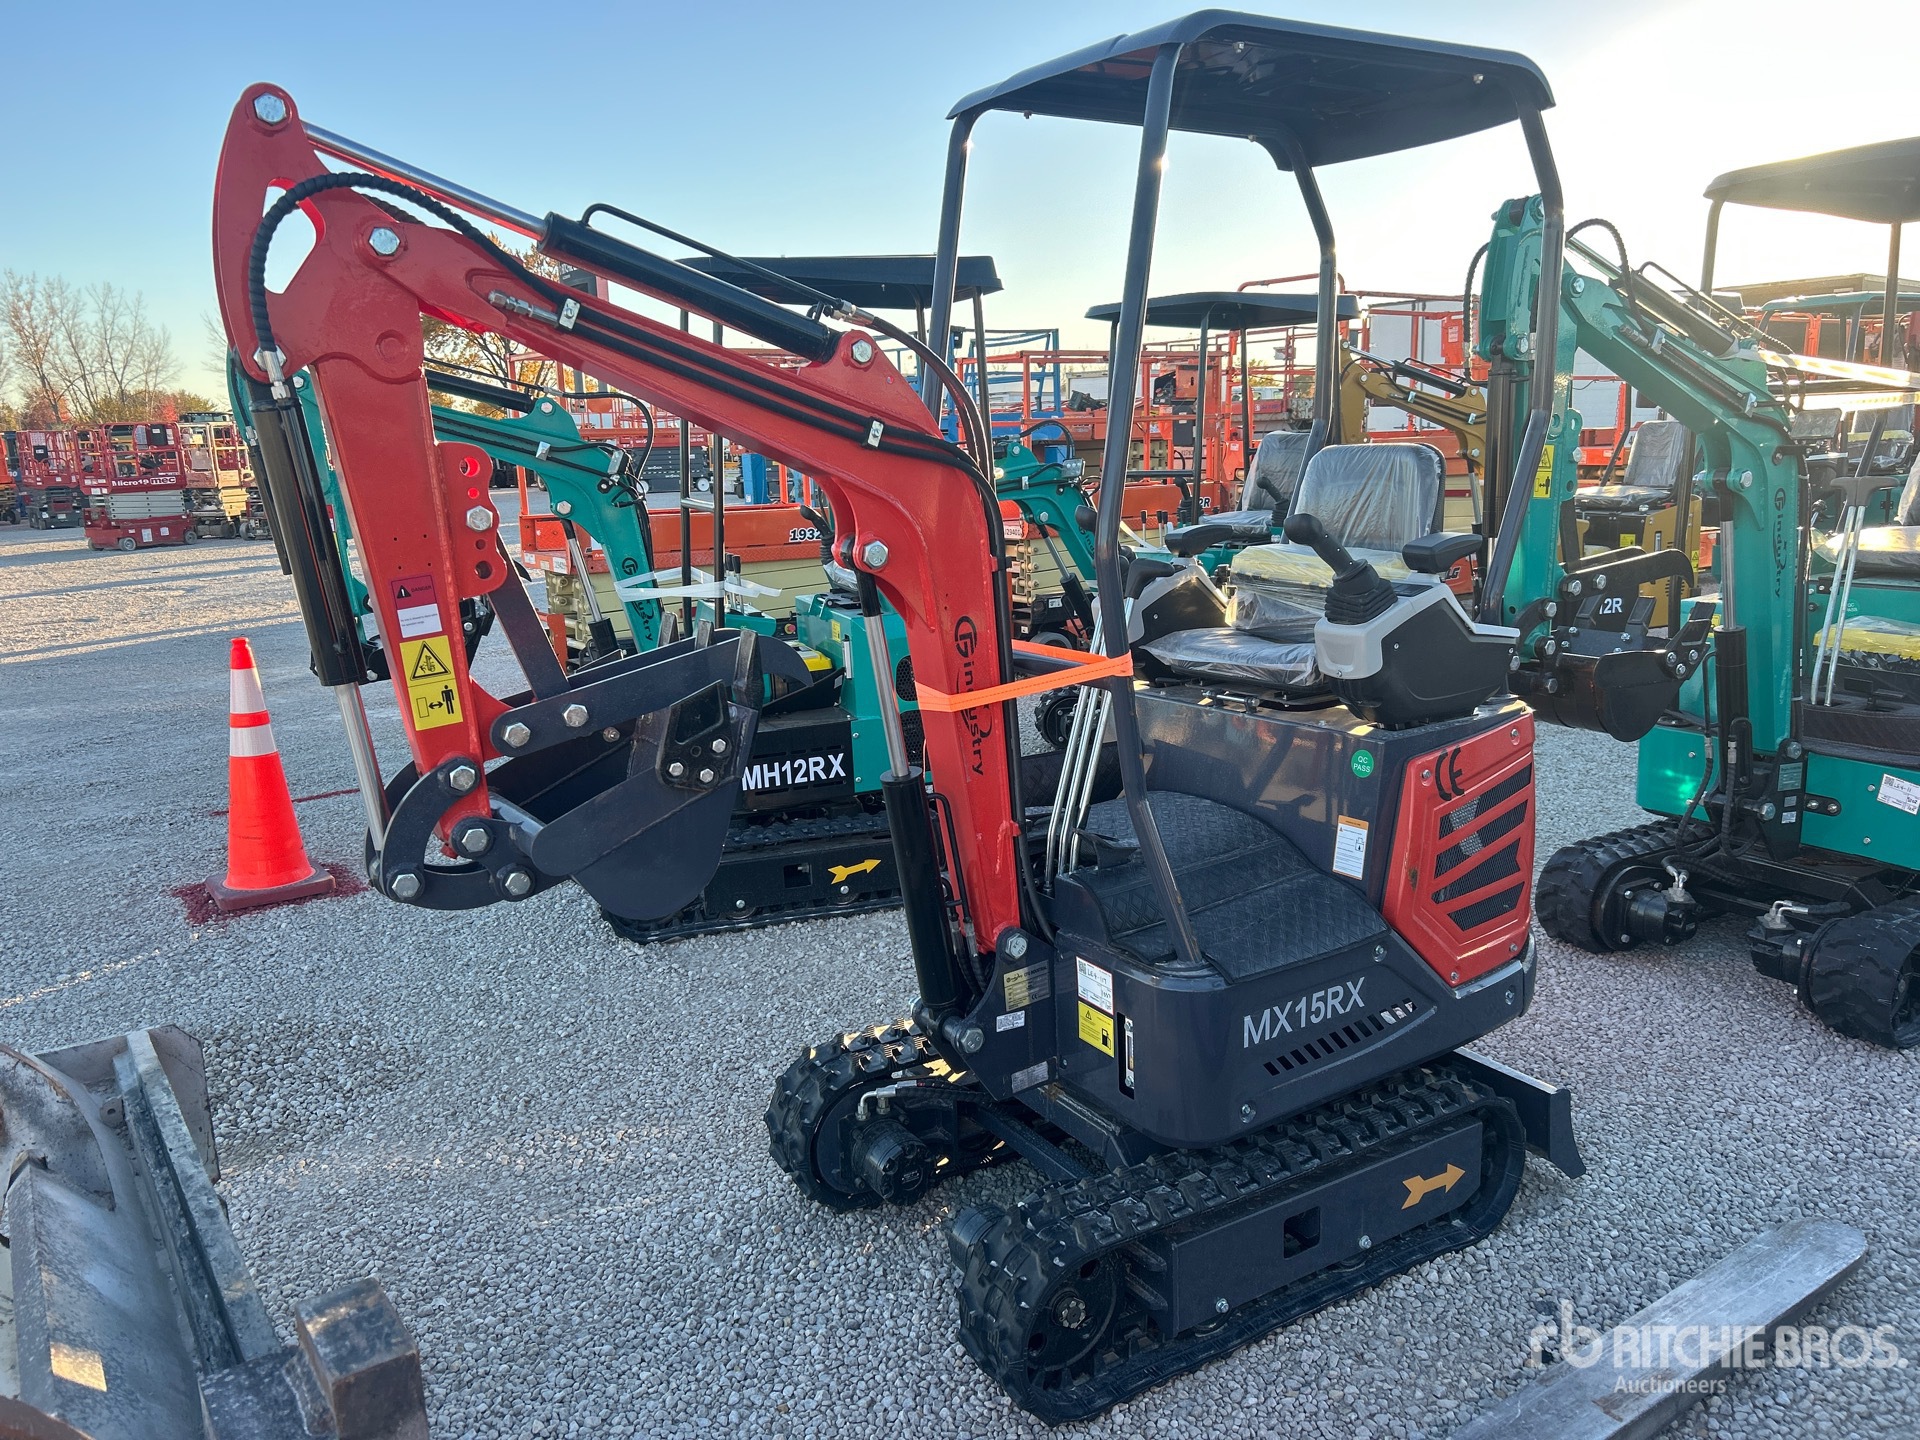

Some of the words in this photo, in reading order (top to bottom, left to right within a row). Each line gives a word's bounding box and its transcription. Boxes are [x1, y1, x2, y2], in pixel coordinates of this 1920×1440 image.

[741, 753, 846, 791] MH12RX
[1353, 763, 1371, 773] PASS
[1357, 755, 1368, 764] QC
[1434, 745, 1465, 801] CE
[1243, 976, 1365, 1049] MX15RX
